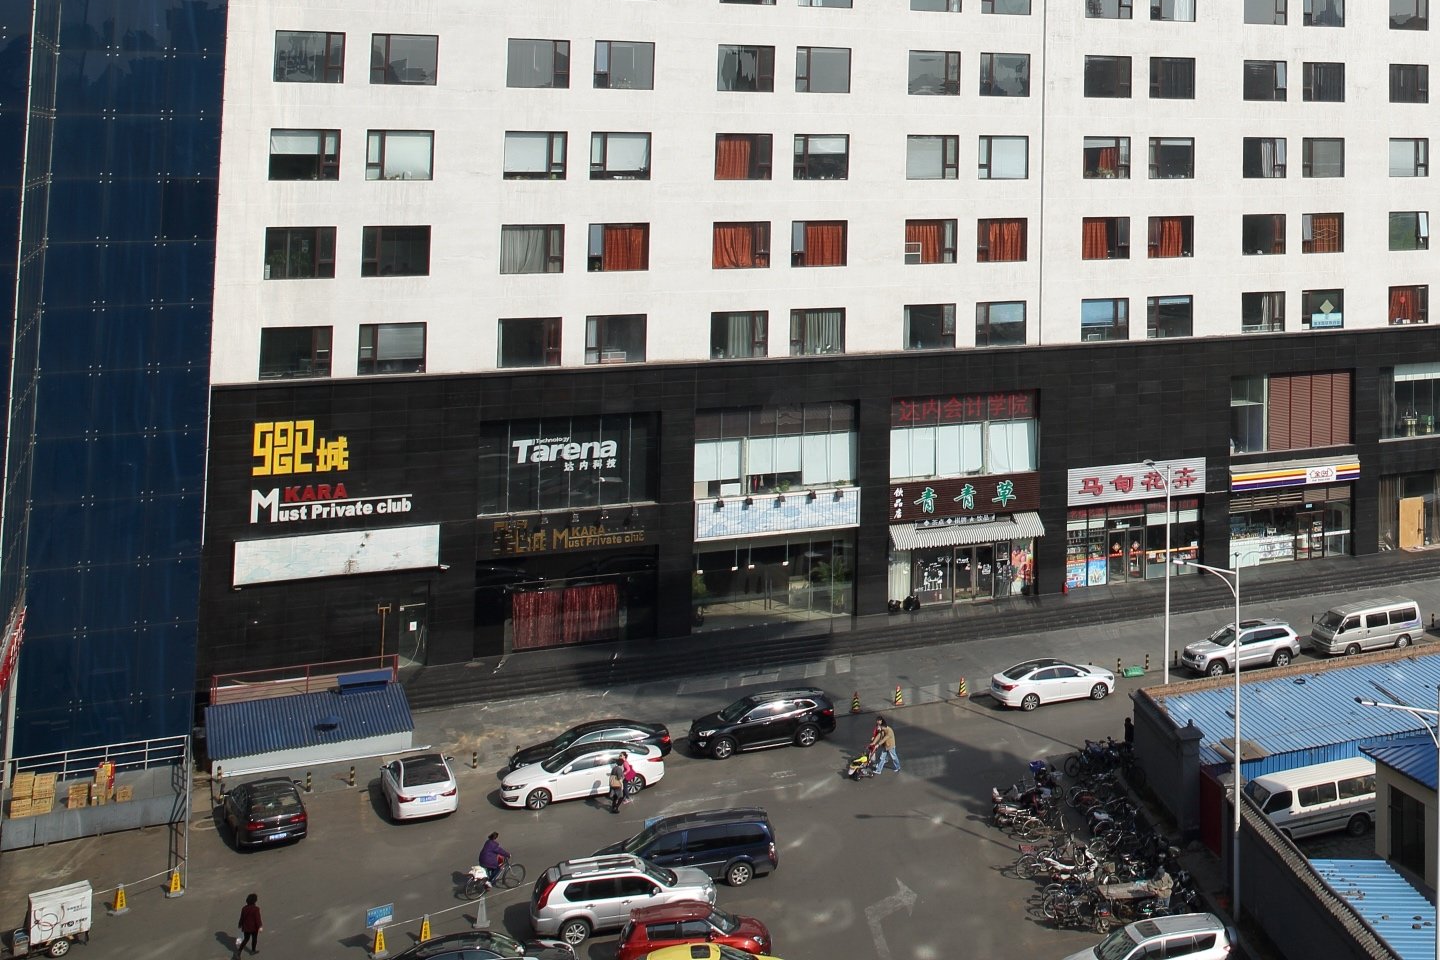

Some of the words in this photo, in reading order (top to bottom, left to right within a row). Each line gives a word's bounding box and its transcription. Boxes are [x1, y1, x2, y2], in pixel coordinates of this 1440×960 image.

[900, 394, 1028, 421] 达内会计学院
[512, 439, 618, 464] Tarena
[563, 458, 617, 472] 达内科技
[284, 482, 348, 503] KARA
[1078, 467, 1198, 497] 马甸花卉
[913, 479, 1017, 514] 青青草
[311, 500, 374, 520] Private
[376, 497, 412, 514] club
[571, 525, 606, 537] KARA
[586, 535, 622, 547] Private
